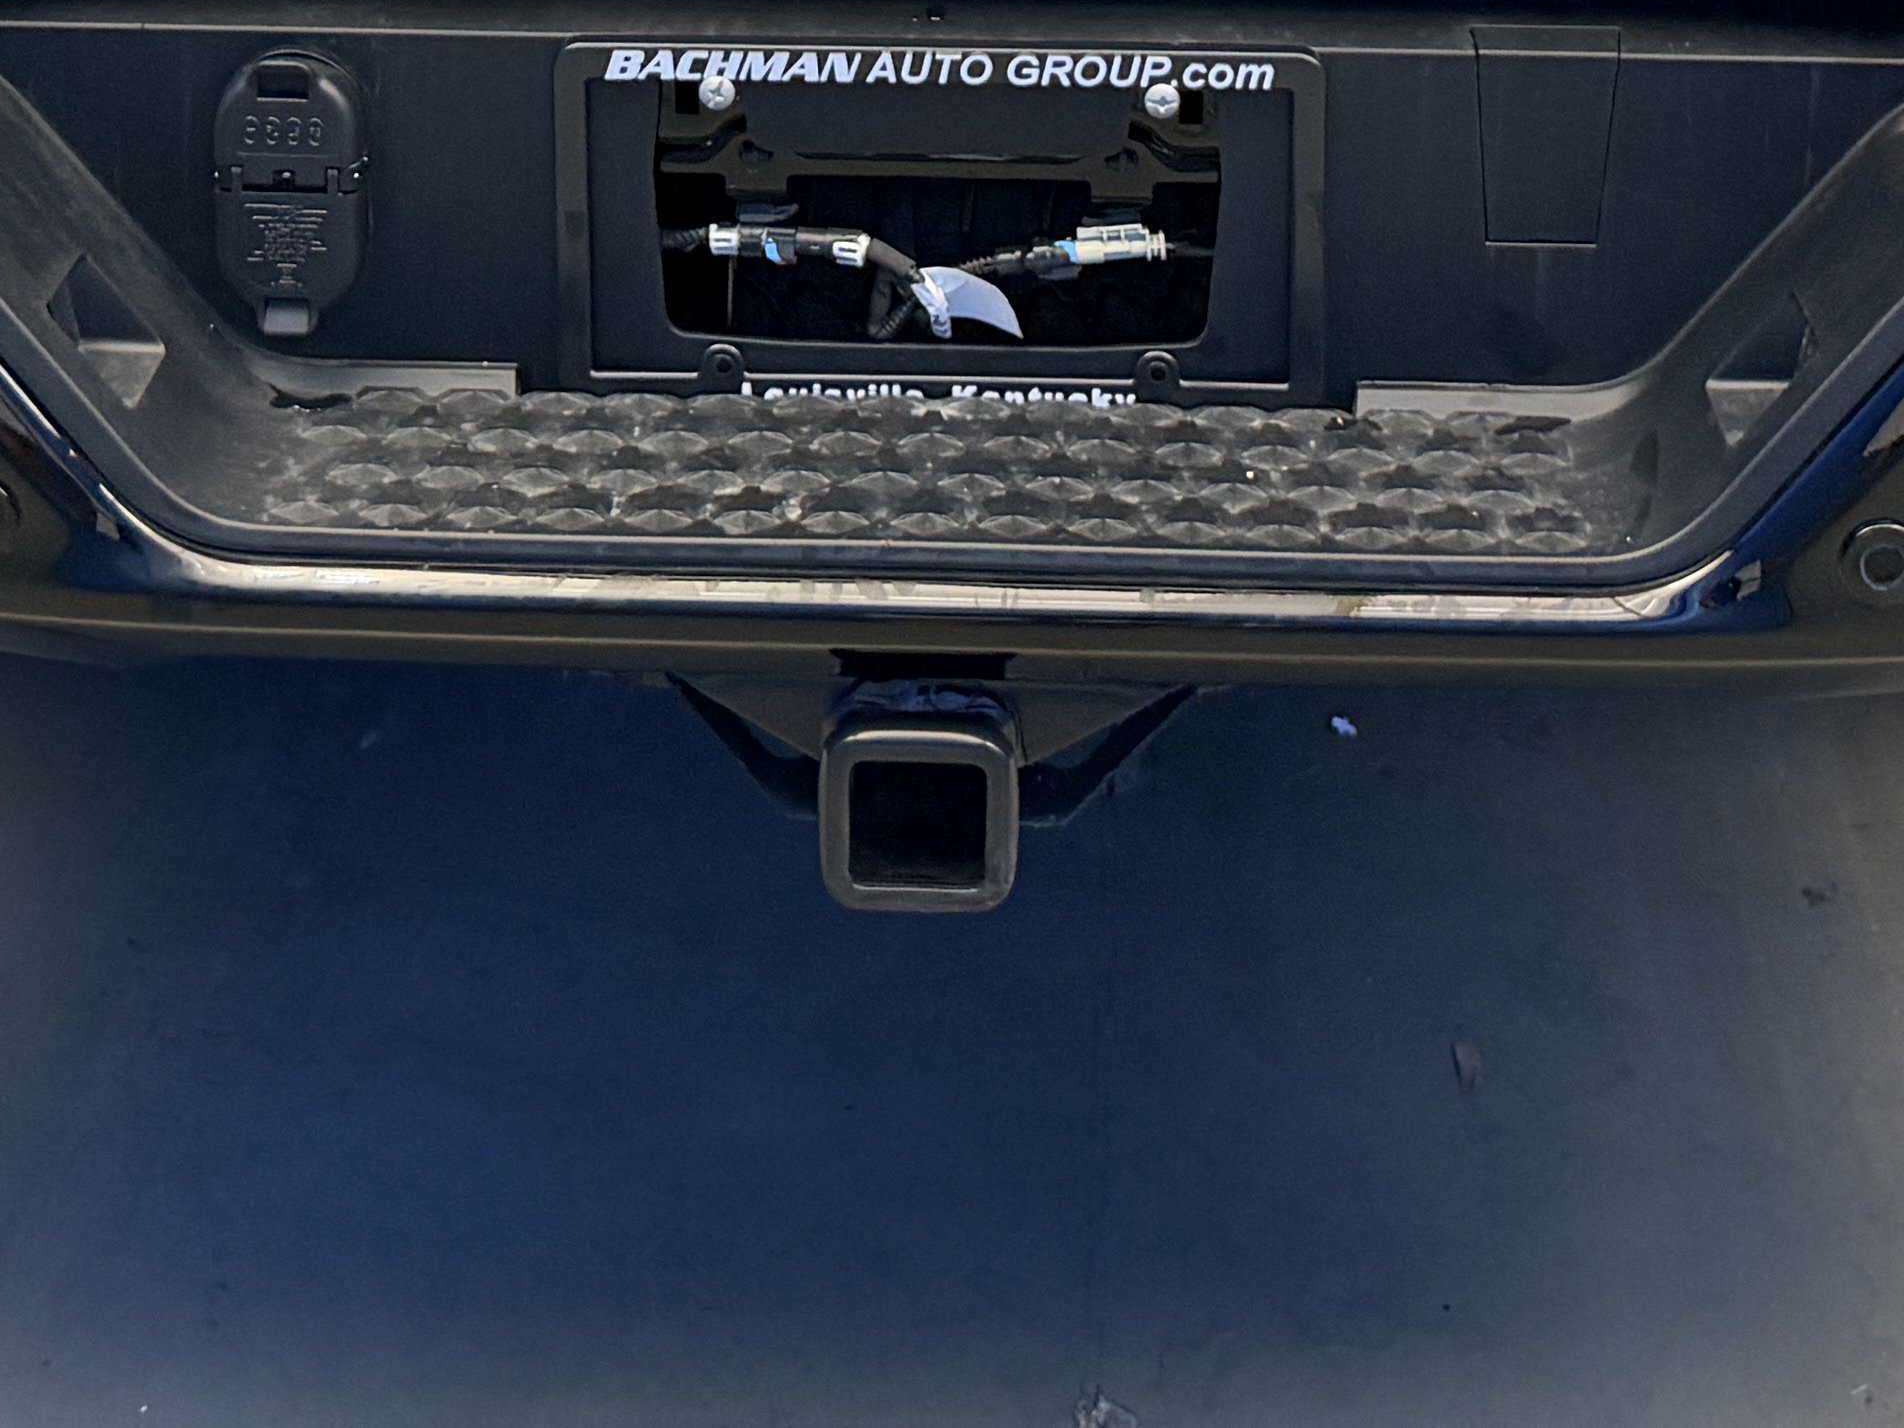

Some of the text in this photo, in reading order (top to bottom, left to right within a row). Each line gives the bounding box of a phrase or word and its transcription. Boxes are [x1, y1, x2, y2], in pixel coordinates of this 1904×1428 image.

[604, 48, 1276, 90] BACHMAN AUTO GROUP.com
